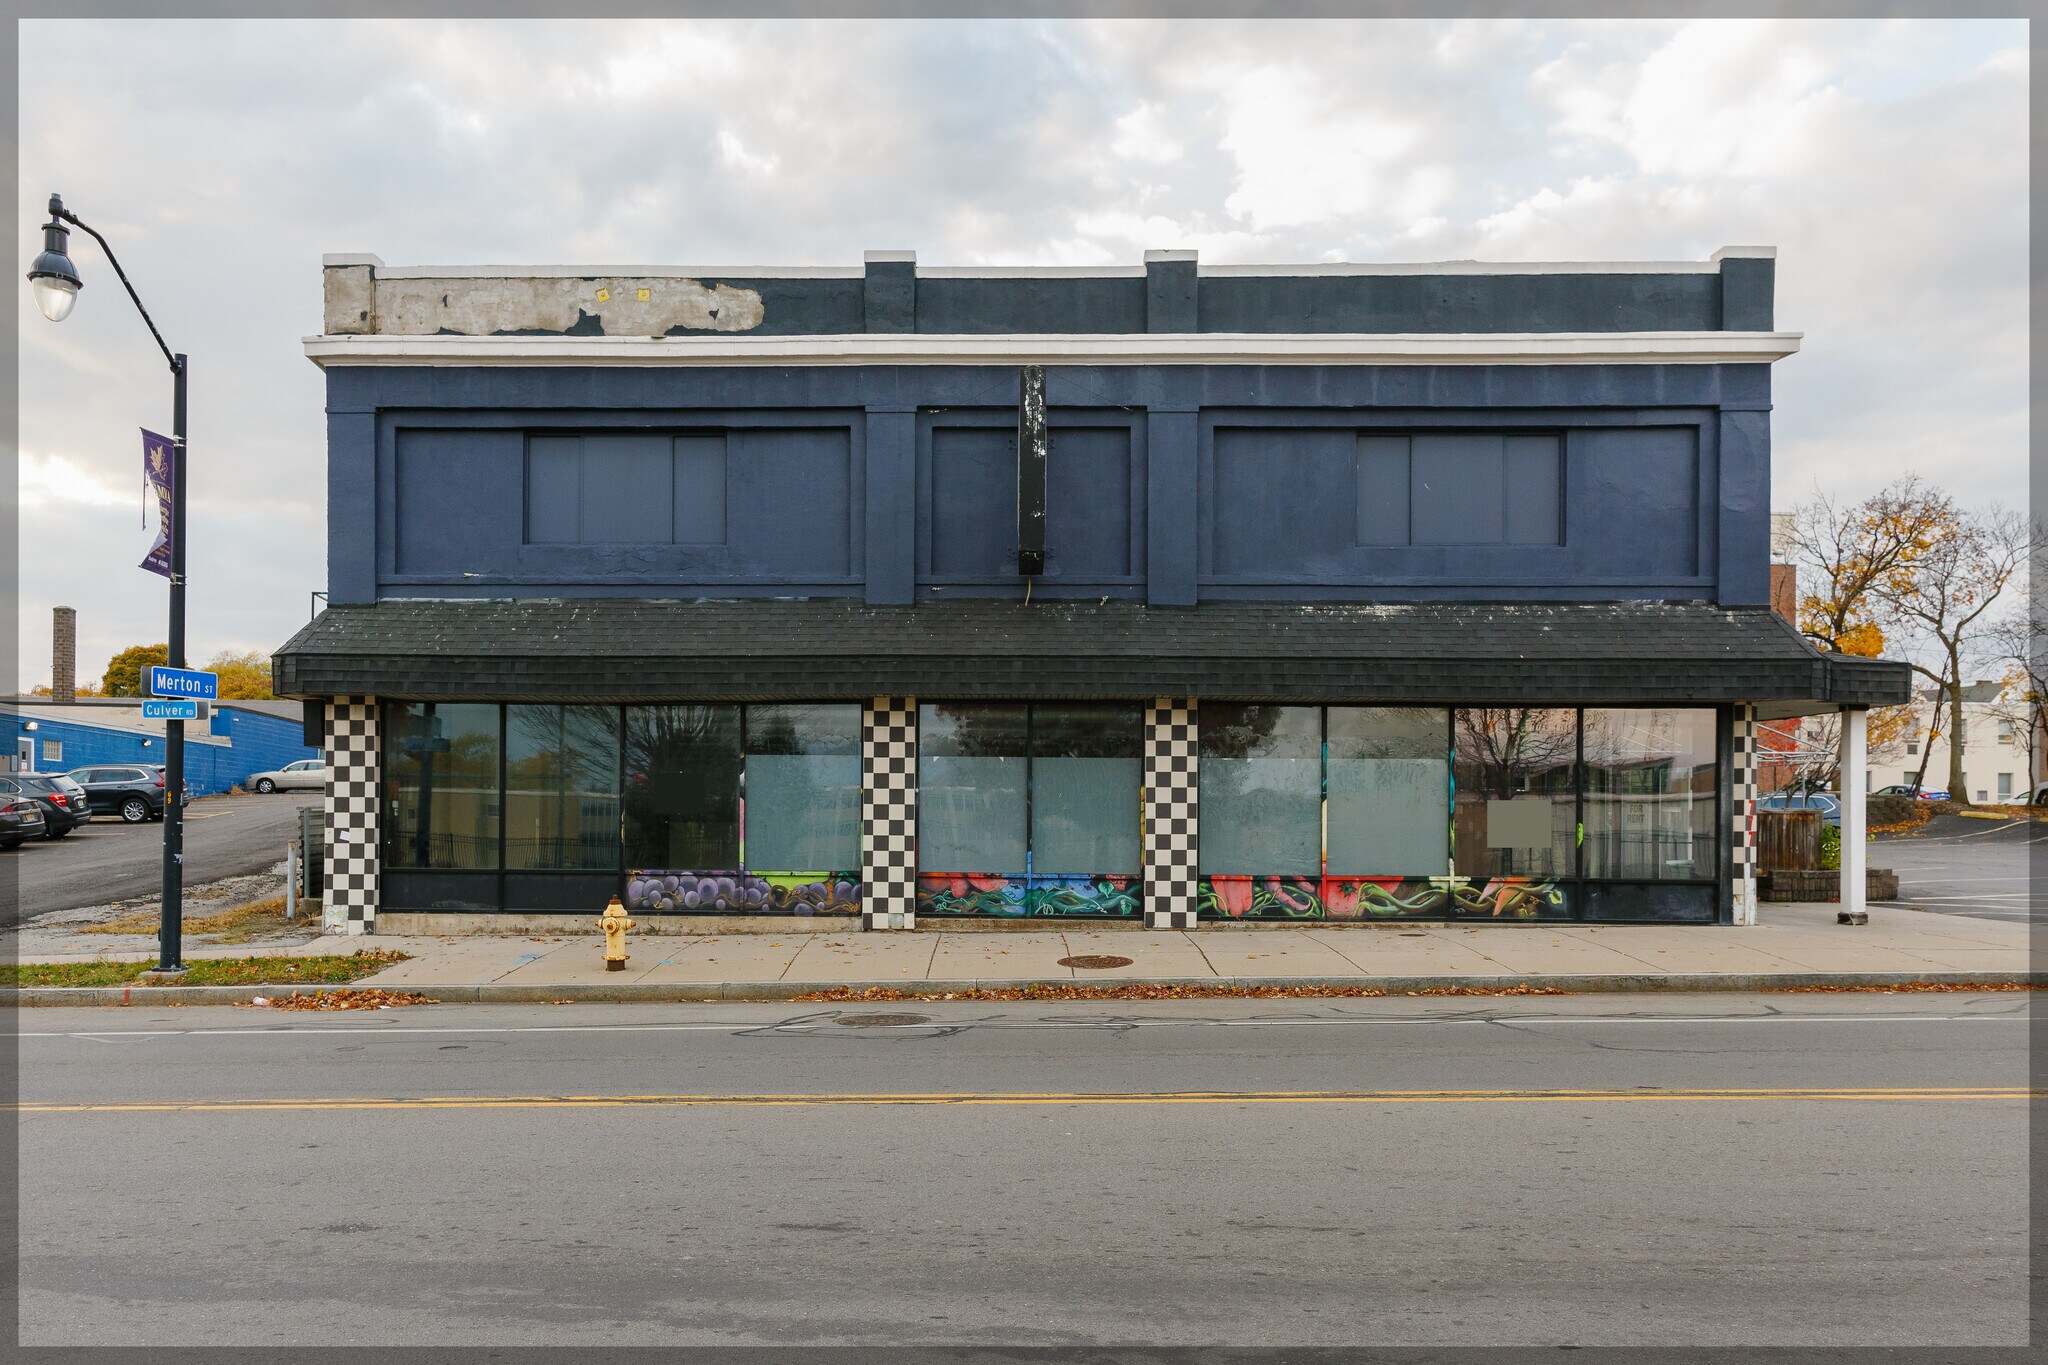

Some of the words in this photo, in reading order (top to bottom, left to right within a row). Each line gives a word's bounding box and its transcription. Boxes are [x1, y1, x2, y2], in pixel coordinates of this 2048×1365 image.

[157, 673, 200, 693] Merton
[204, 685, 213, 693] ST
[146, 704, 183, 716] Culver
[1630, 804, 1643, 813] FOR
[1627, 814, 1644, 823] RENT
